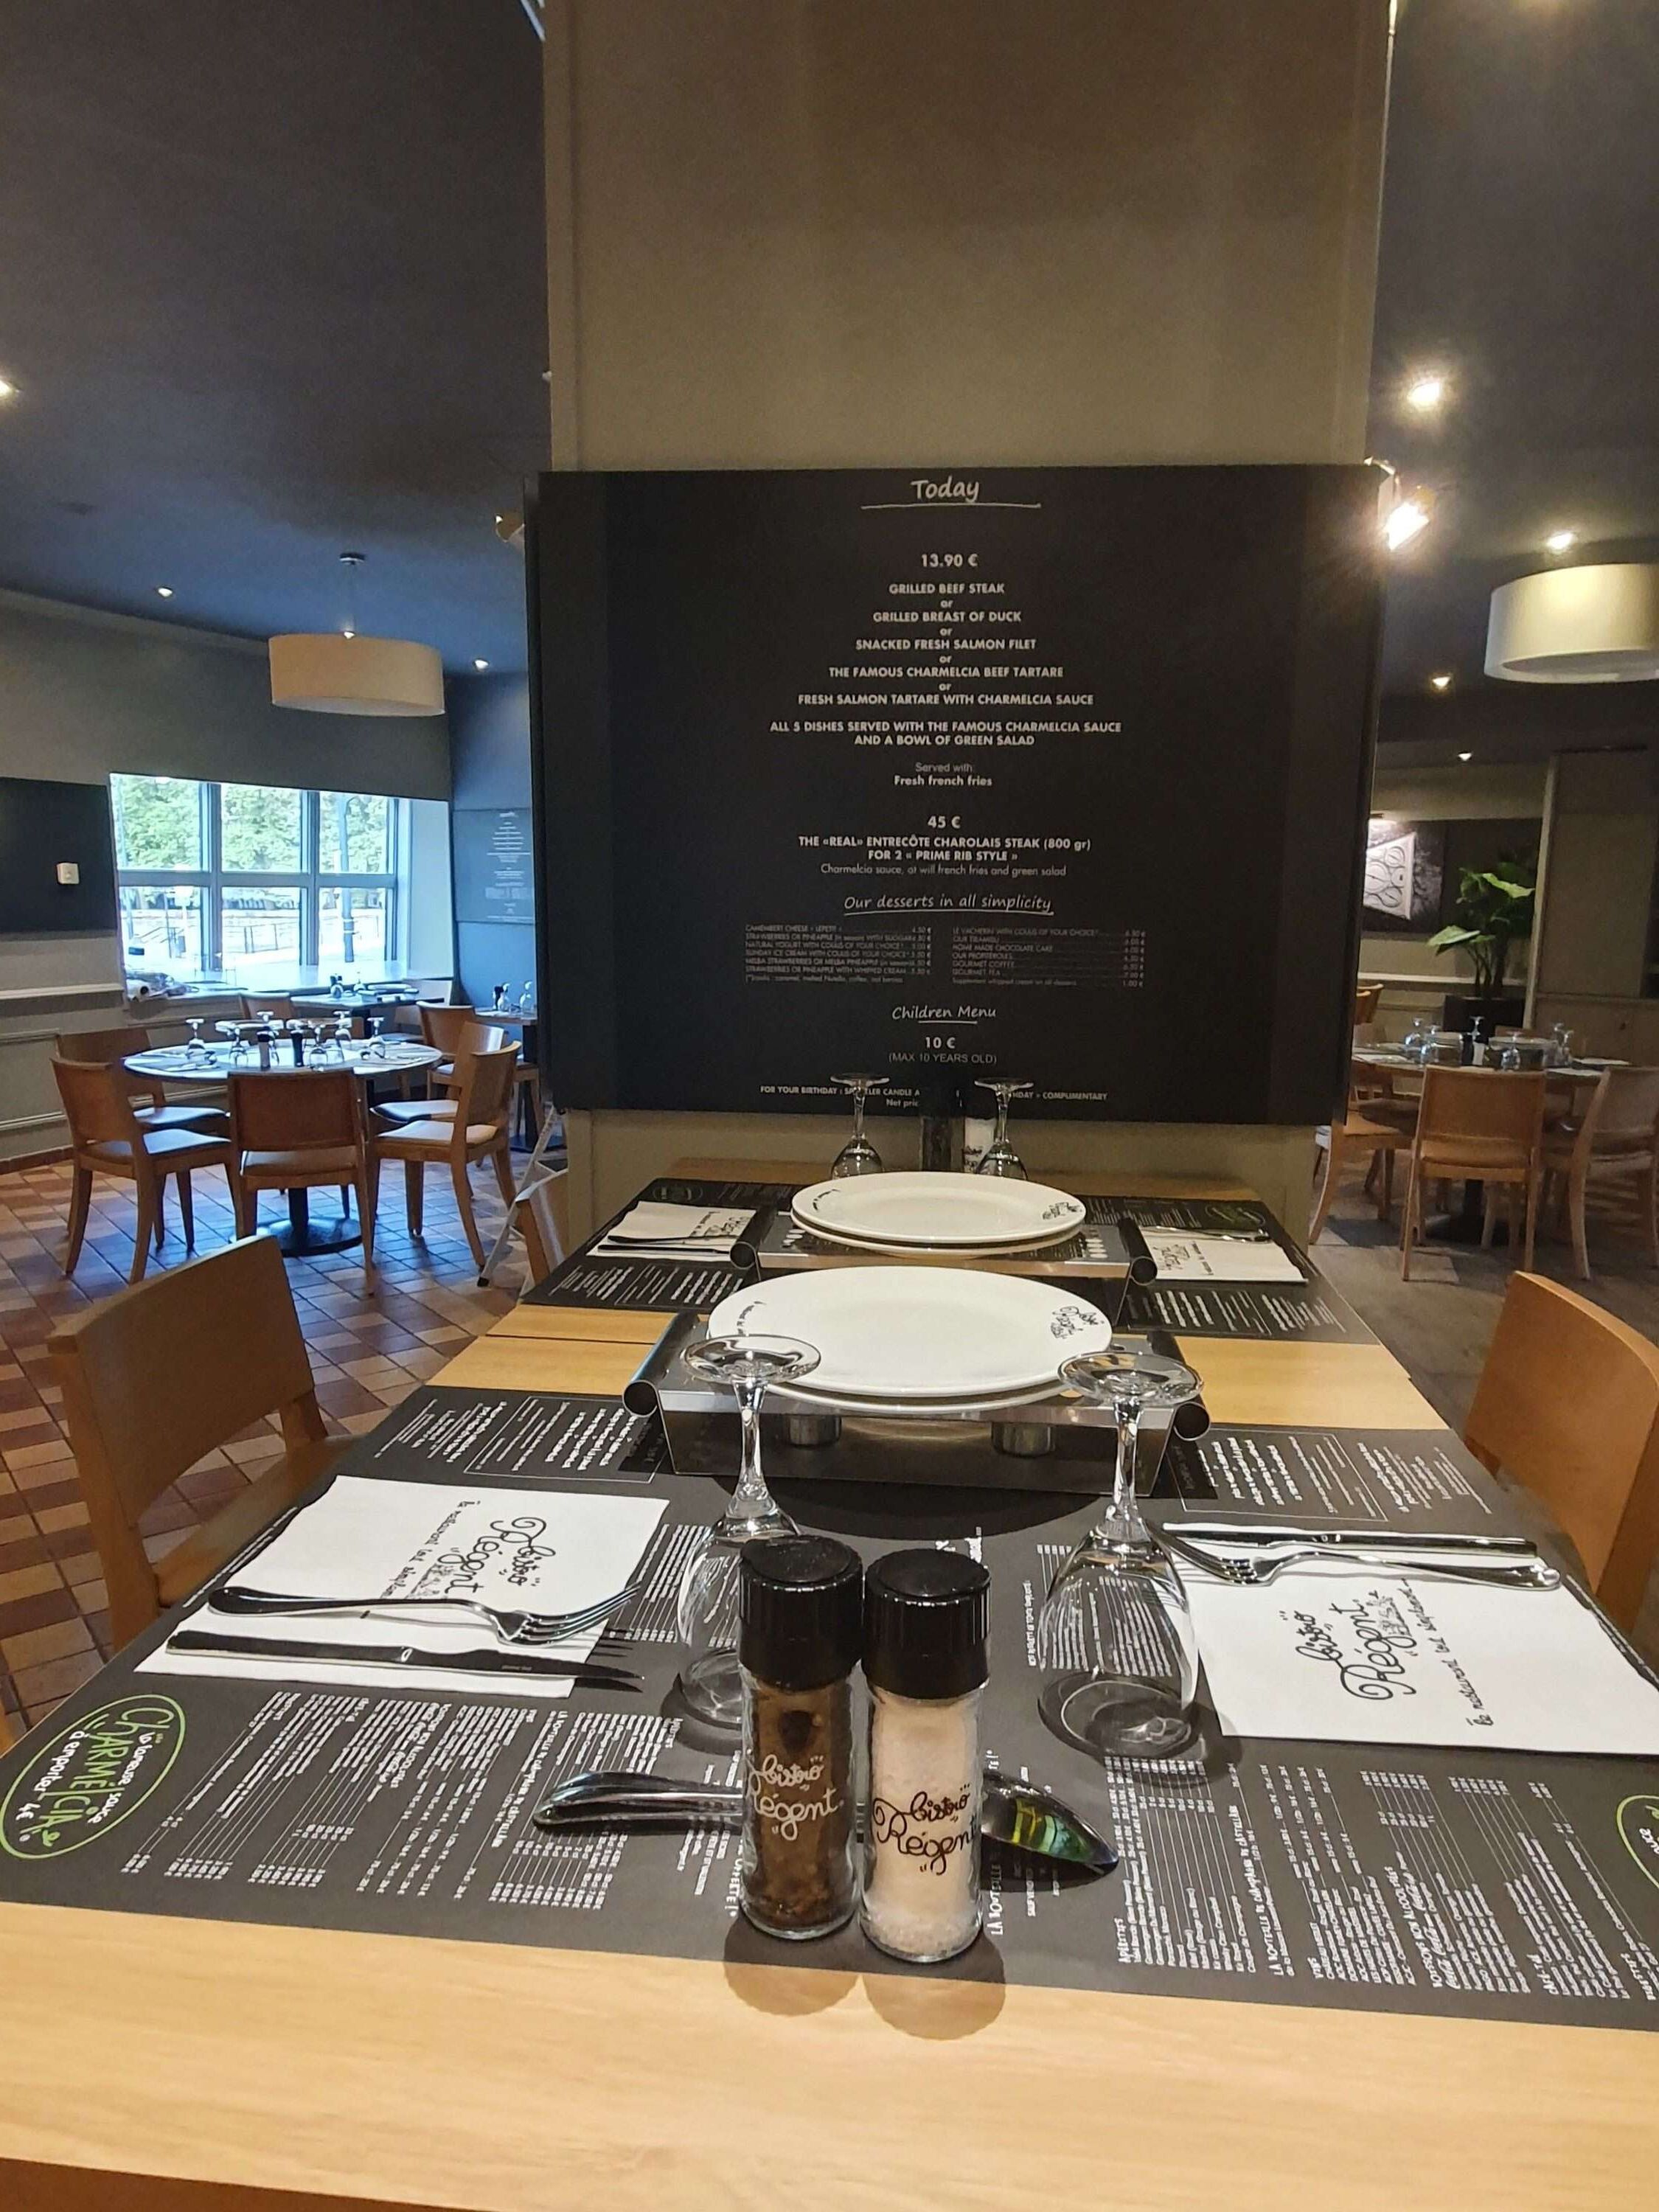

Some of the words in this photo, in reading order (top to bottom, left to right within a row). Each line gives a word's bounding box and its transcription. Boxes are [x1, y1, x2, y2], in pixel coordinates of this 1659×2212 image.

[910, 475, 979, 504] Today
[921, 553, 963, 568] 13.90
[967, 553, 978, 567] €
[888, 583, 936, 594] GRILLED
[939, 583, 965, 594] BEEF
[969, 582, 1005, 594] STEAK
[940, 600, 953, 608] or
[873, 611, 919, 622] GRILLED
[922, 611, 966, 622] BREAST
[968, 611, 985, 622] OF
[988, 611, 1022, 622] DUCK
[939, 627, 953, 636] or
[855, 639, 911, 650] SNACKED
[914, 639, 950, 650] FRESH
[953, 639, 1006, 650] SALMON
[1009, 639, 1037, 650] FILET
[939, 655, 952, 664] or
[829, 667, 849, 678] THE
[852, 667, 904, 678] FAMOUS
[906, 667, 981, 678] CHARMELCIA
[984, 667, 1010, 678] BEEF
[1013, 667, 1063, 678] TARTARE
[939, 683, 952, 692] or
[798, 694, 833, 705] FRESH
[836, 694, 888, 705] SALMON
[891, 694, 939, 705] TARTARE
[942, 694, 975, 705] WITH
[977, 694, 1052, 705] CHARMELCIA
[1056, 695, 1093, 705] SAUCE
[770, 721, 790, 732] ALL
[793, 721, 801, 732] 5
[804, 721, 844, 732] DISHES
[847, 721, 891, 732] SERVED
[893, 721, 925, 732] WITH
[927, 721, 948, 732] THE
[952, 721, 1003, 732] FAMOUS
[1005, 721, 1080, 732] CHARMELCIA
[1084, 721, 1121, 733] SAUCE
[854, 734, 881, 745] AND
[883, 734, 894, 745] A
[897, 734, 932, 746] BOWL
[934, 734, 951, 745] OF
[954, 734, 993, 745] GREEN
[997, 734, 1035, 746] SALAD
[915, 762, 950, 773] Served
[894, 774, 925, 786] Fresh
[928, 774, 964, 786] french
[967, 774, 992, 786] fries
[928, 815, 946, 829] 45
[951, 815, 960, 829] €
[798, 835, 820, 846] THE
[933, 836, 1001, 848] CHAROLAIS
[1004, 838, 1040, 849] STEAK
[1043, 838, 1071, 850] (800
[868, 849, 891, 860] FOR
[894, 849, 902, 860] 2
[916, 849, 950, 861] PRIME
[954, 850, 973, 861] RIB
[976, 851, 1007, 861] STYLE
[844, 897, 872, 908] Our
[877, 894, 934, 908] desserts
[940, 894, 953, 907] in
[959, 894, 976, 908] all
[981, 894, 1051, 912] simplicity
[891, 1004, 953, 1020] Children
[957, 1005, 996, 1018] Menu
[925, 1037, 942, 1048] 10
[946, 1037, 956, 1049] €
[888, 1051, 915, 1063] (MAX
[919, 1053, 931, 1062] 10
[932, 1053, 969, 1063] YEARS
[970, 1053, 997, 1065] OLD)
[777, 1085, 799, 1094] YOUR
[33, 1741, 80, 1792] emporter
[87, 1792, 122, 1824] sauce
